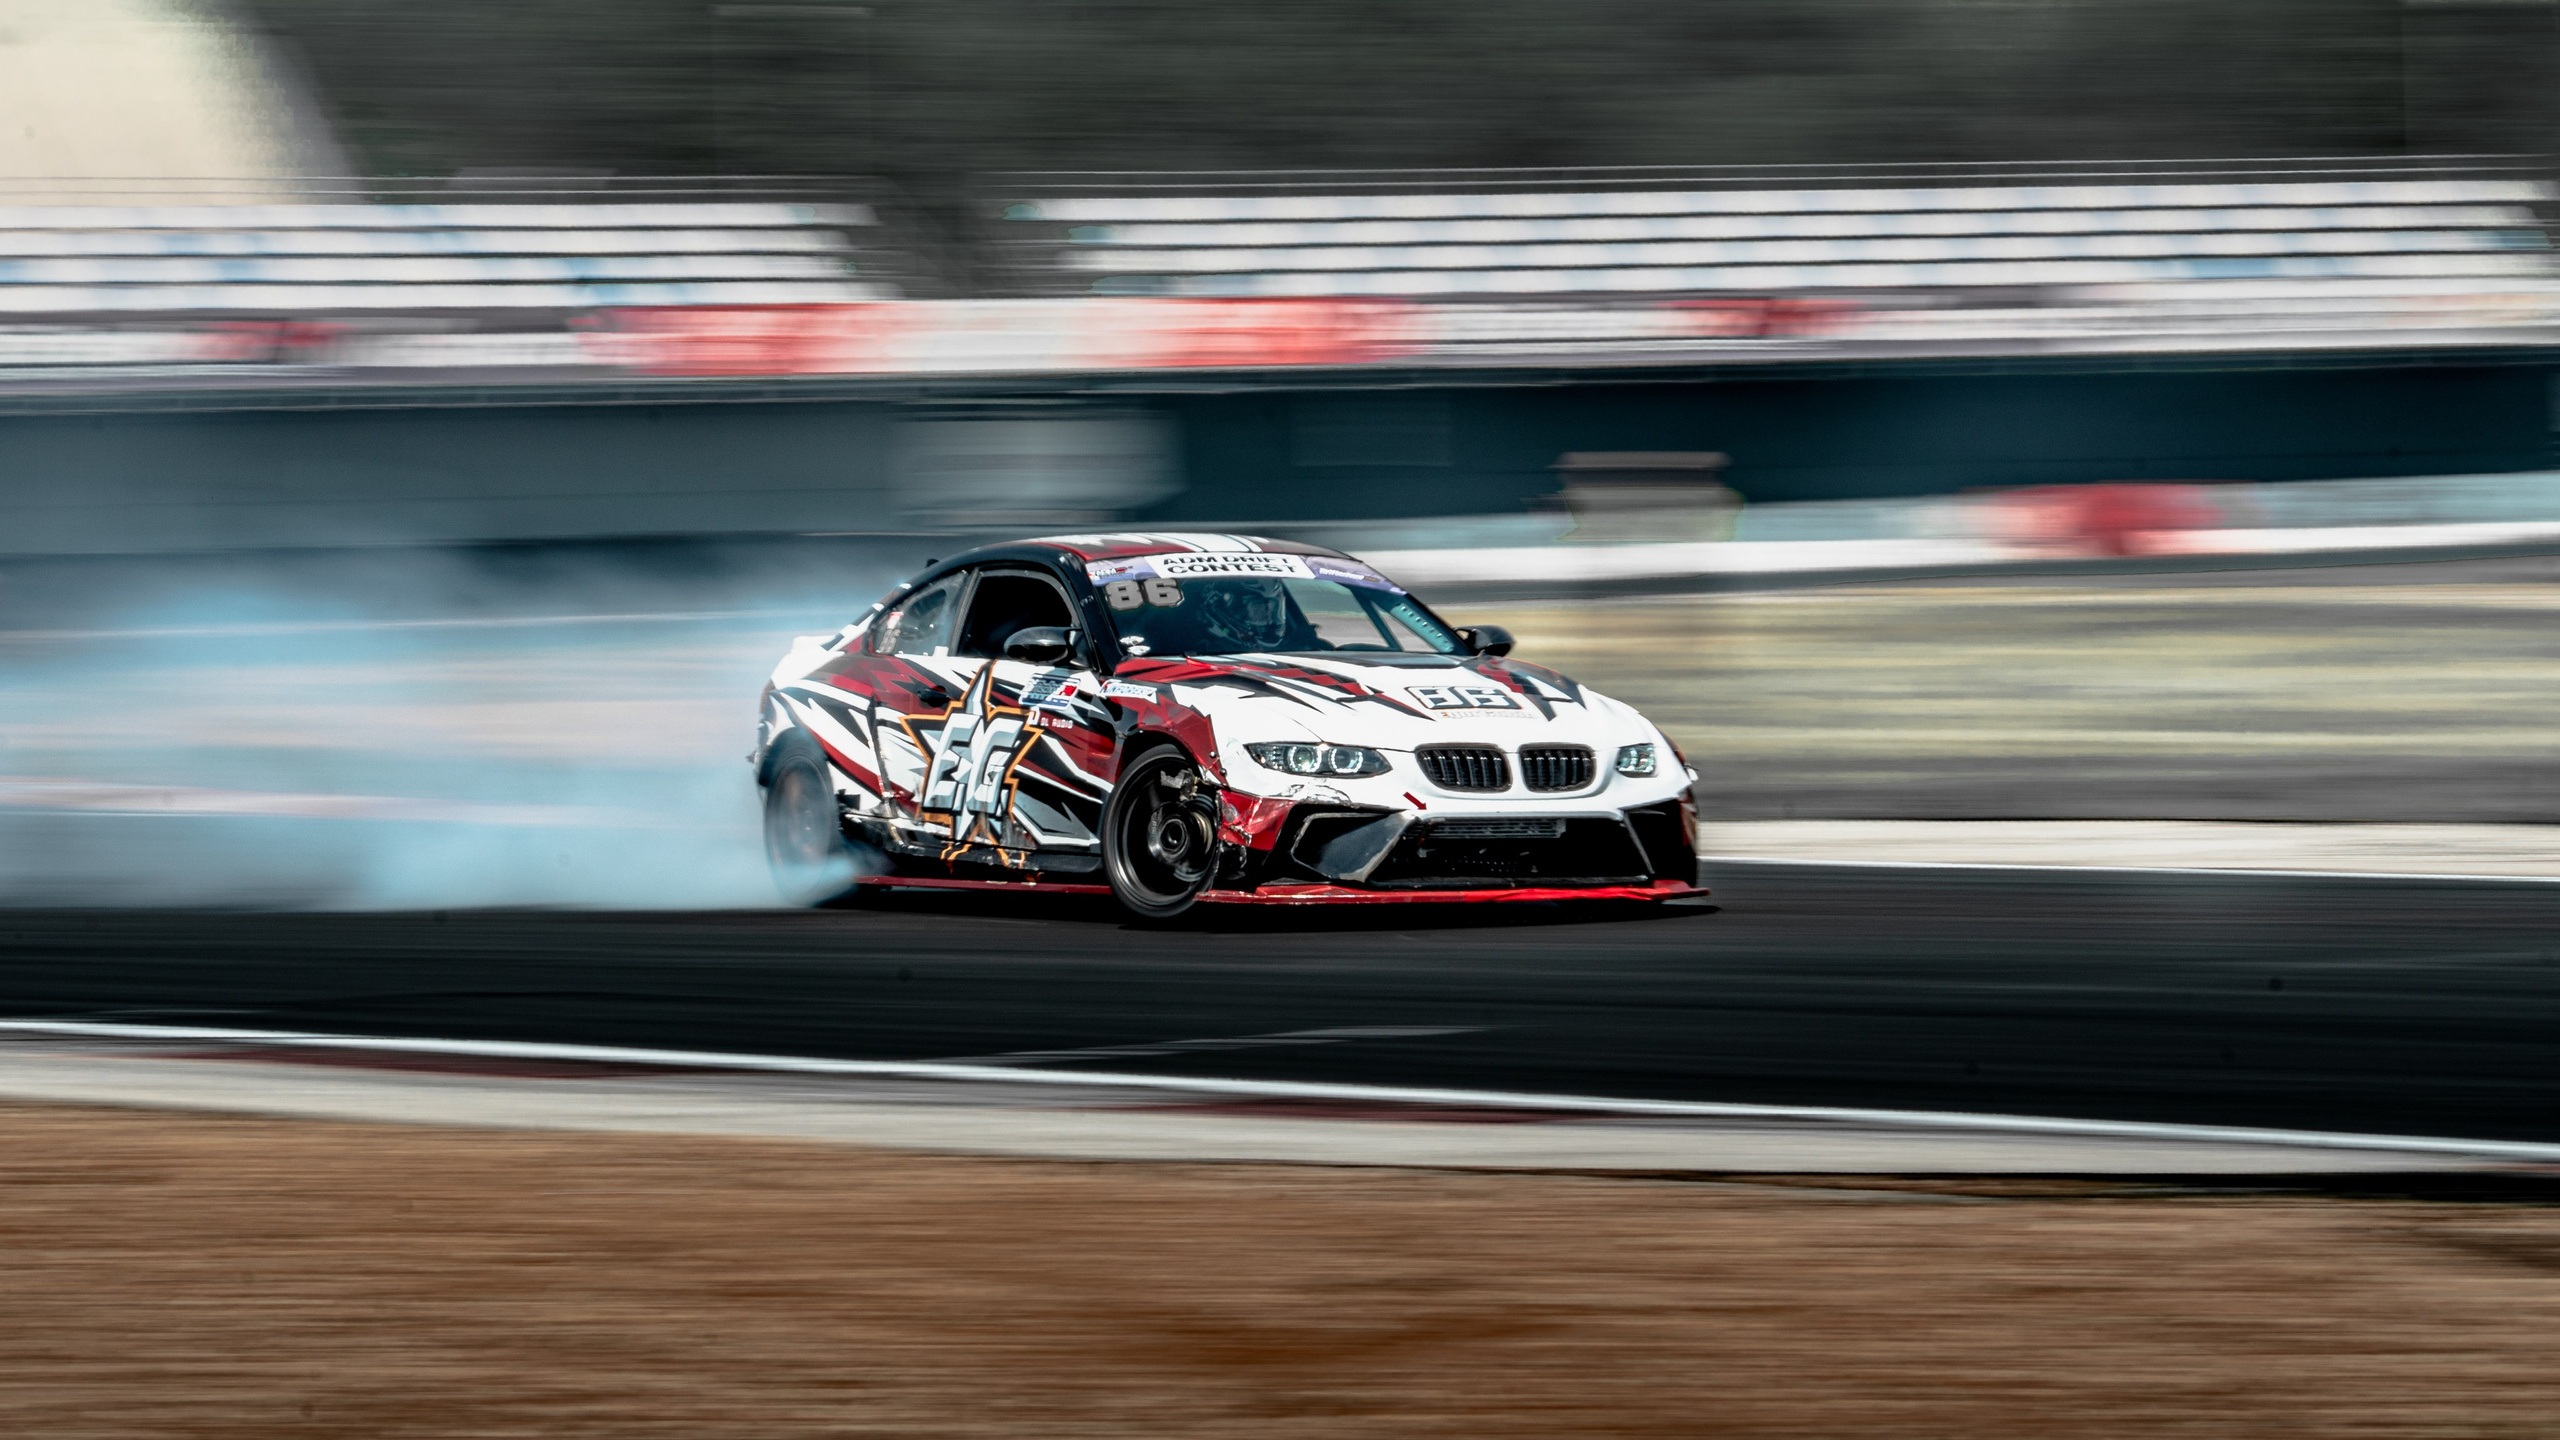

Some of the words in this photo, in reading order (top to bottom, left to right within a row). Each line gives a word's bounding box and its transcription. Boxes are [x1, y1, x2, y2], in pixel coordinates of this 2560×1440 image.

[1163, 556, 1218, 565] ADM
[1222, 556, 1290, 564] DRIFT
[1167, 563, 1298, 574] CONTEST
[1105, 578, 1183, 611] 86
[1405, 686, 1521, 709] 86
[1051, 717, 1074, 729] AUDIO
